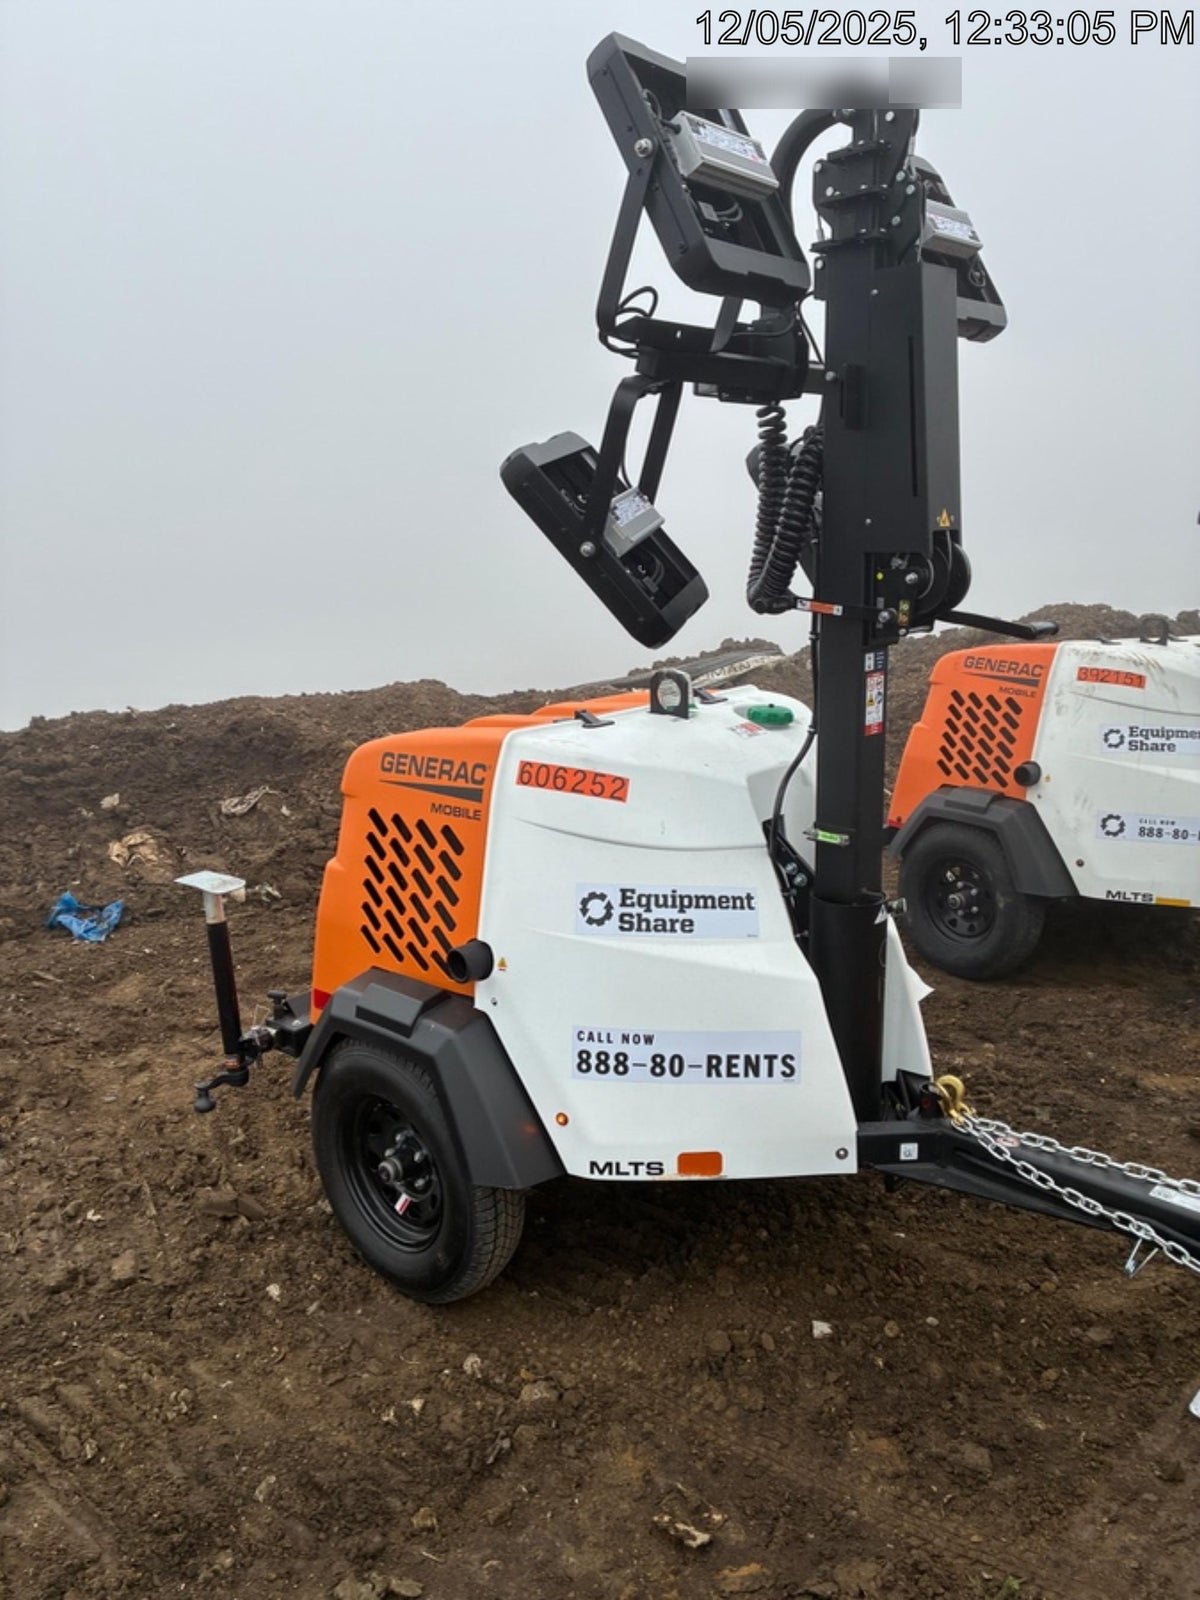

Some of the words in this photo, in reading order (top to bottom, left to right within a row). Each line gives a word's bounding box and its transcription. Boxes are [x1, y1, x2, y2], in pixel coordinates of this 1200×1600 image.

[963, 655, 1044, 677] GENERAC
[999, 686, 1037, 698] MOBILE
[1128, 739, 1176, 752] Share
[379, 751, 487, 786] GENERAC
[518, 762, 627, 800] 606252
[430, 802, 481, 821] MOBILE
[1138, 826, 1200, 841] 888-80-
[618, 887, 755, 914] Equipment
[1105, 890, 1153, 902] MLTS
[618, 911, 694, 933] Share
[576, 1030, 614, 1044] CALL
[621, 1033, 655, 1046] NOW
[576, 1049, 796, 1079] 888-80-RENTS
[588, 1160, 665, 1176] MLTS
